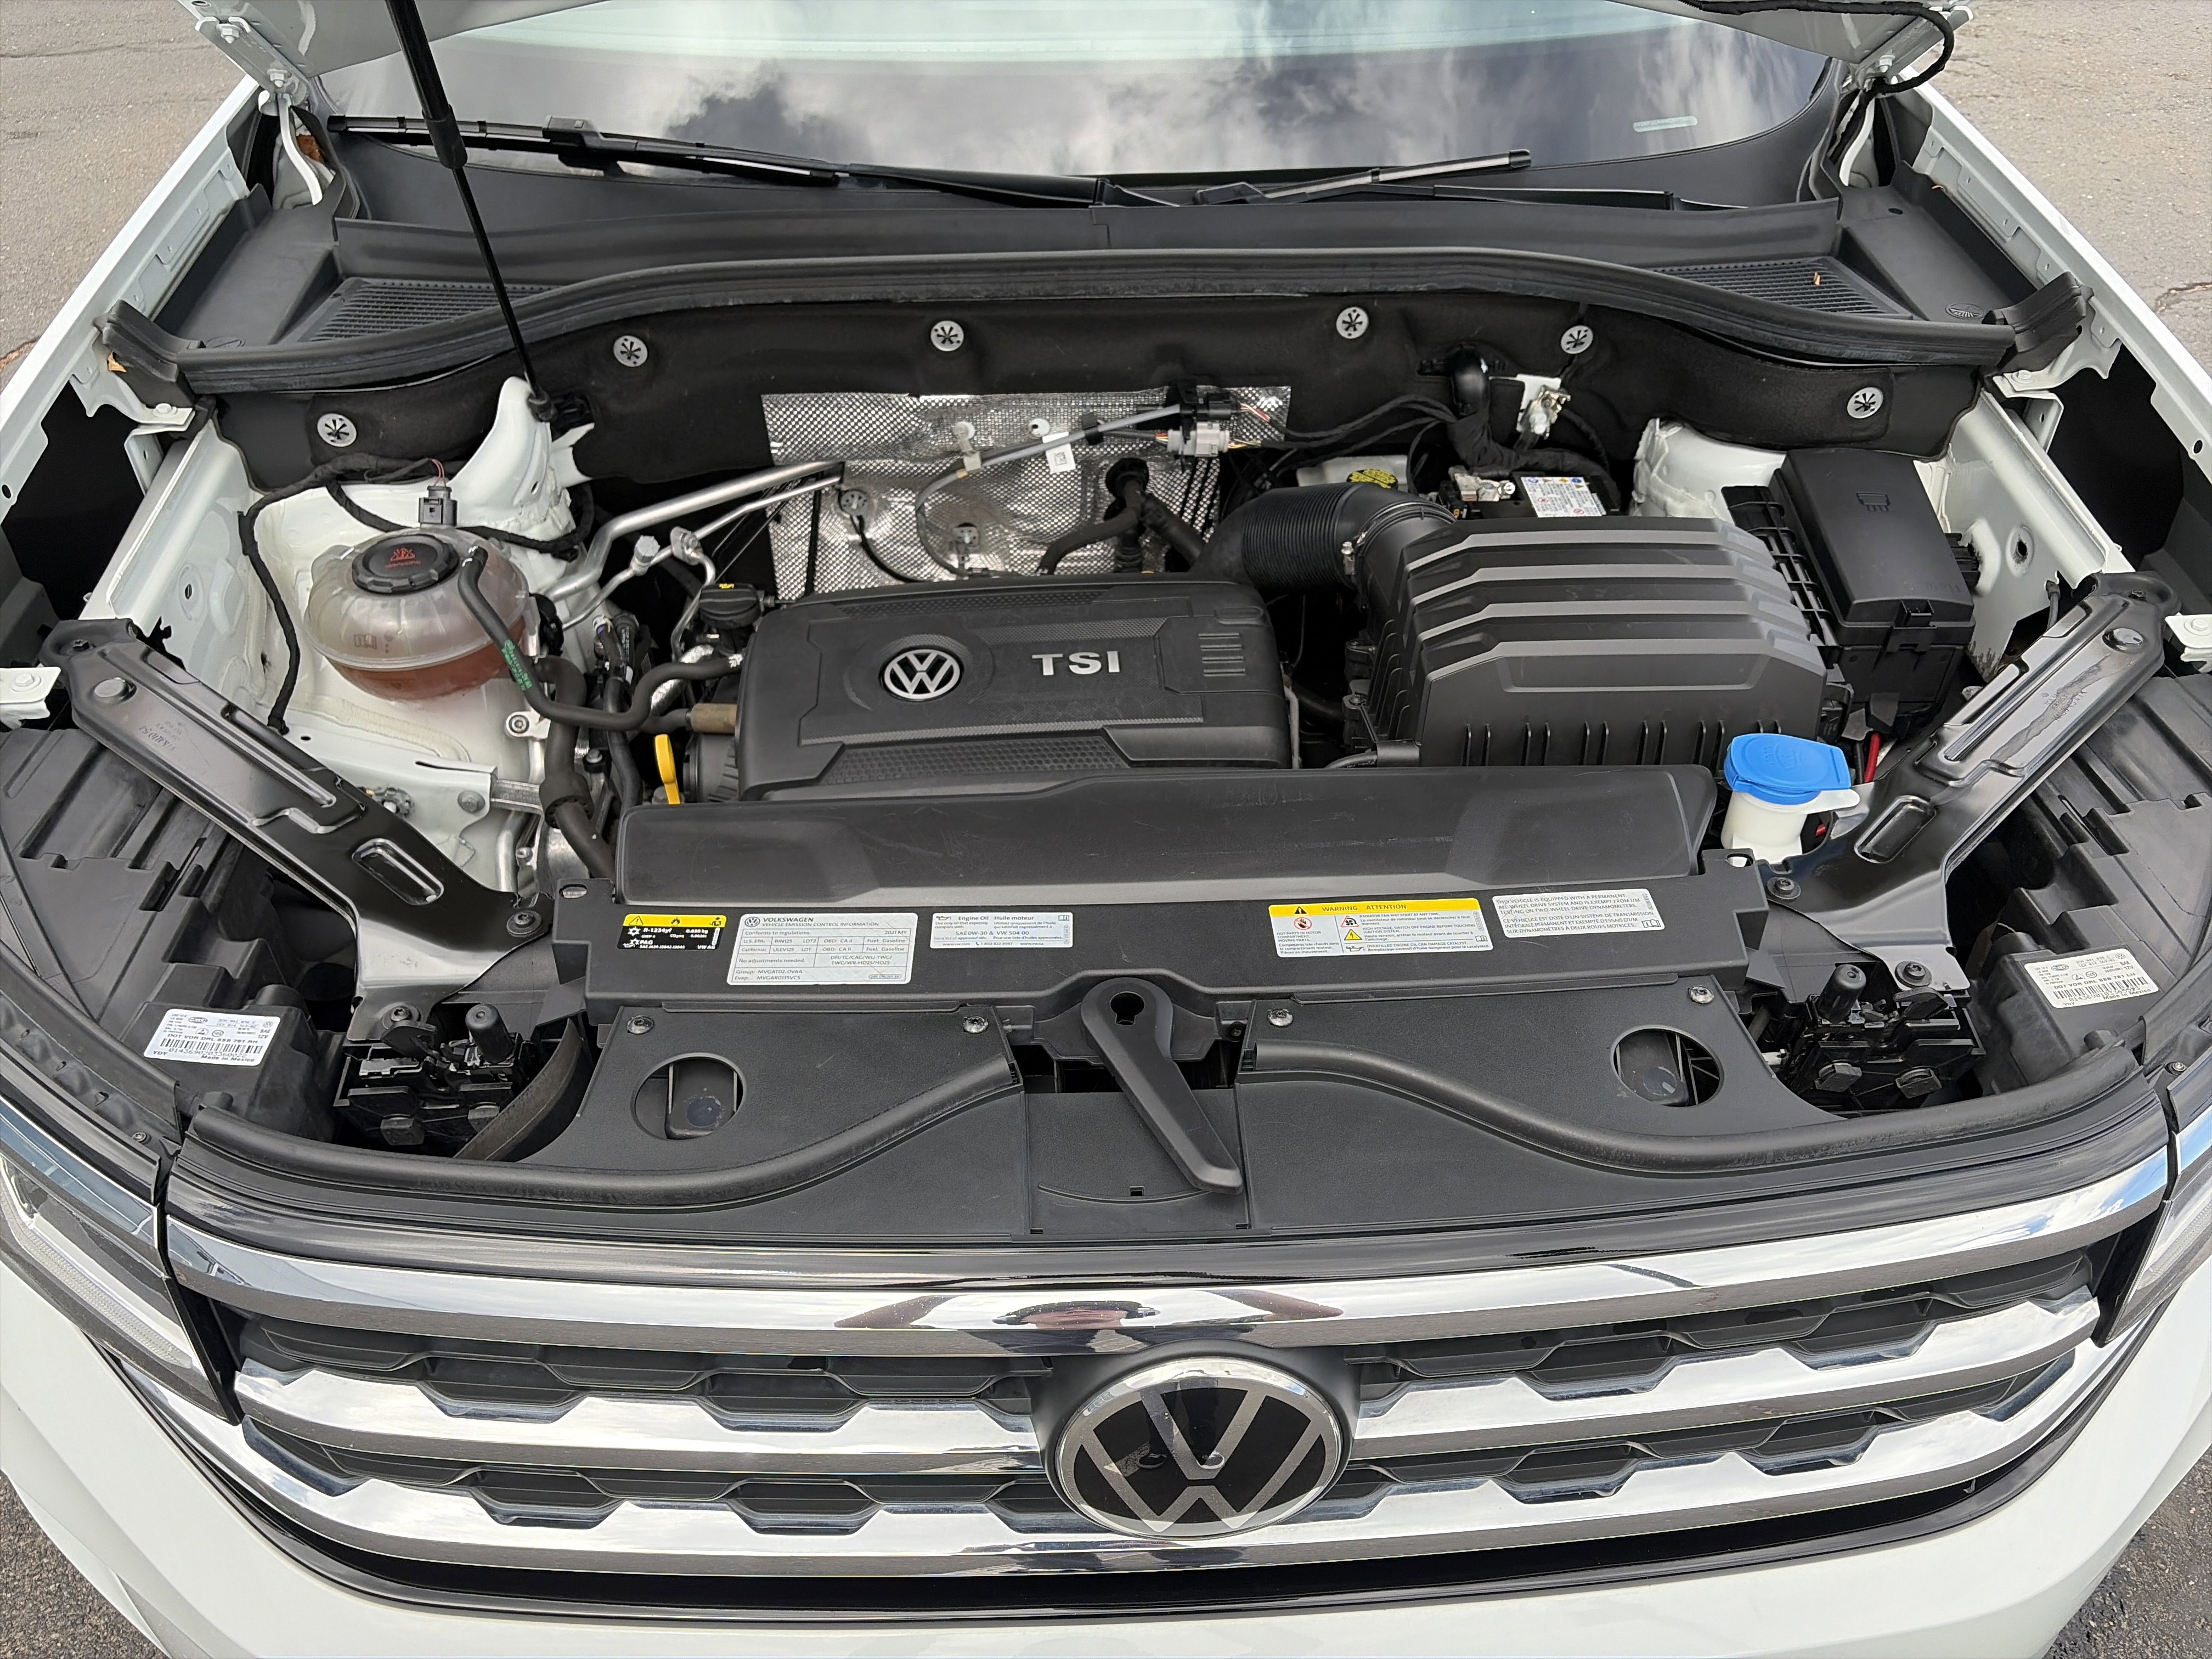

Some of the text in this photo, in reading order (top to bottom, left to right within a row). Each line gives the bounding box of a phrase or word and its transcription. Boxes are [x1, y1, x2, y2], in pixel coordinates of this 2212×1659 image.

[882, 648, 962, 701] VW
[1032, 651, 1120, 676] TSI
[1058, 1357, 1342, 1538] VW
